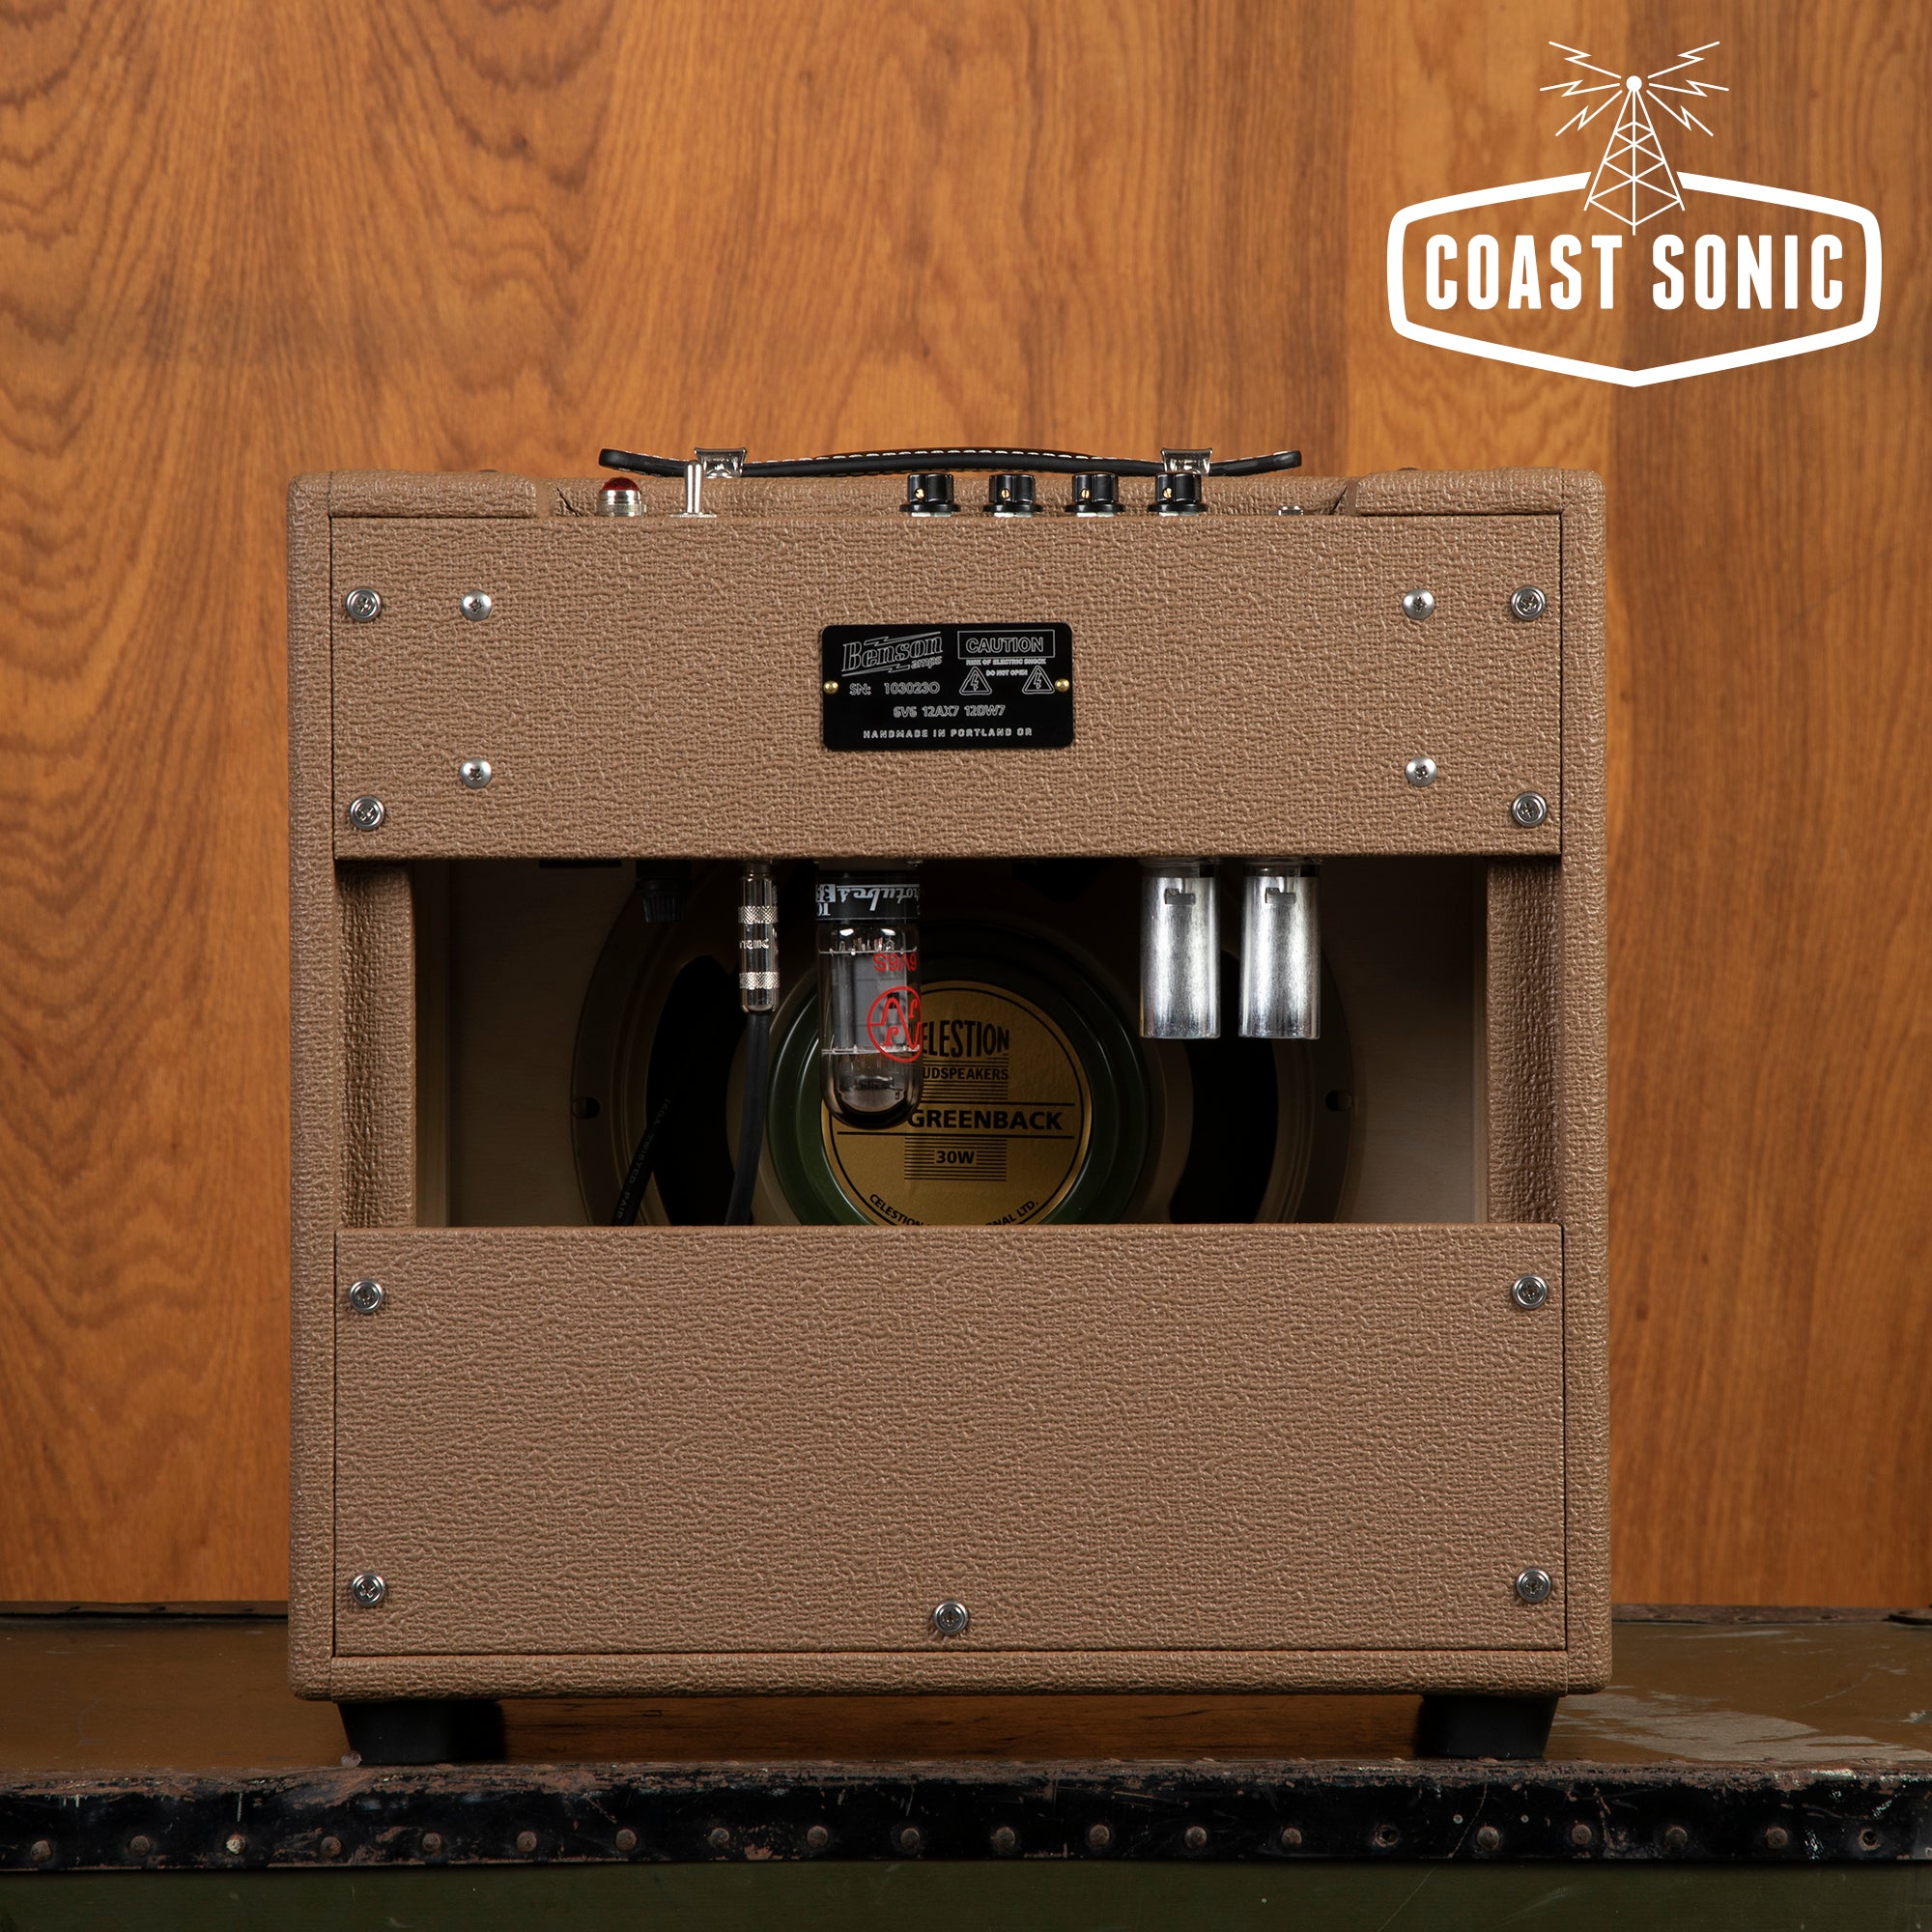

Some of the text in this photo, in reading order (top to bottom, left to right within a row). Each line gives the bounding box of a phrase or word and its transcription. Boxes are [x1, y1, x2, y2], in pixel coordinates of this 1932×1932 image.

[965, 637, 1044, 653] CAUTION
[842, 636, 943, 671] Benson
[911, 656, 943, 671] amps
[849, 683, 871, 696] SN:
[894, 705, 1006, 718] 6V6 12AX7 12DW7
[863, 727, 1033, 739] HANDMADE IN PORTLAND OR
[872, 952, 917, 972] 6V6S
[922, 1019, 1009, 1058] ELESTION
[922, 1066, 1009, 1080] UDSPEAKERS
[907, 1110, 1063, 1130] GREENBACK
[935, 1151, 975, 1165] 30W
[616, 1191, 631, 1219] PAIR
[1016, 1200, 1039, 1218] LTD.
